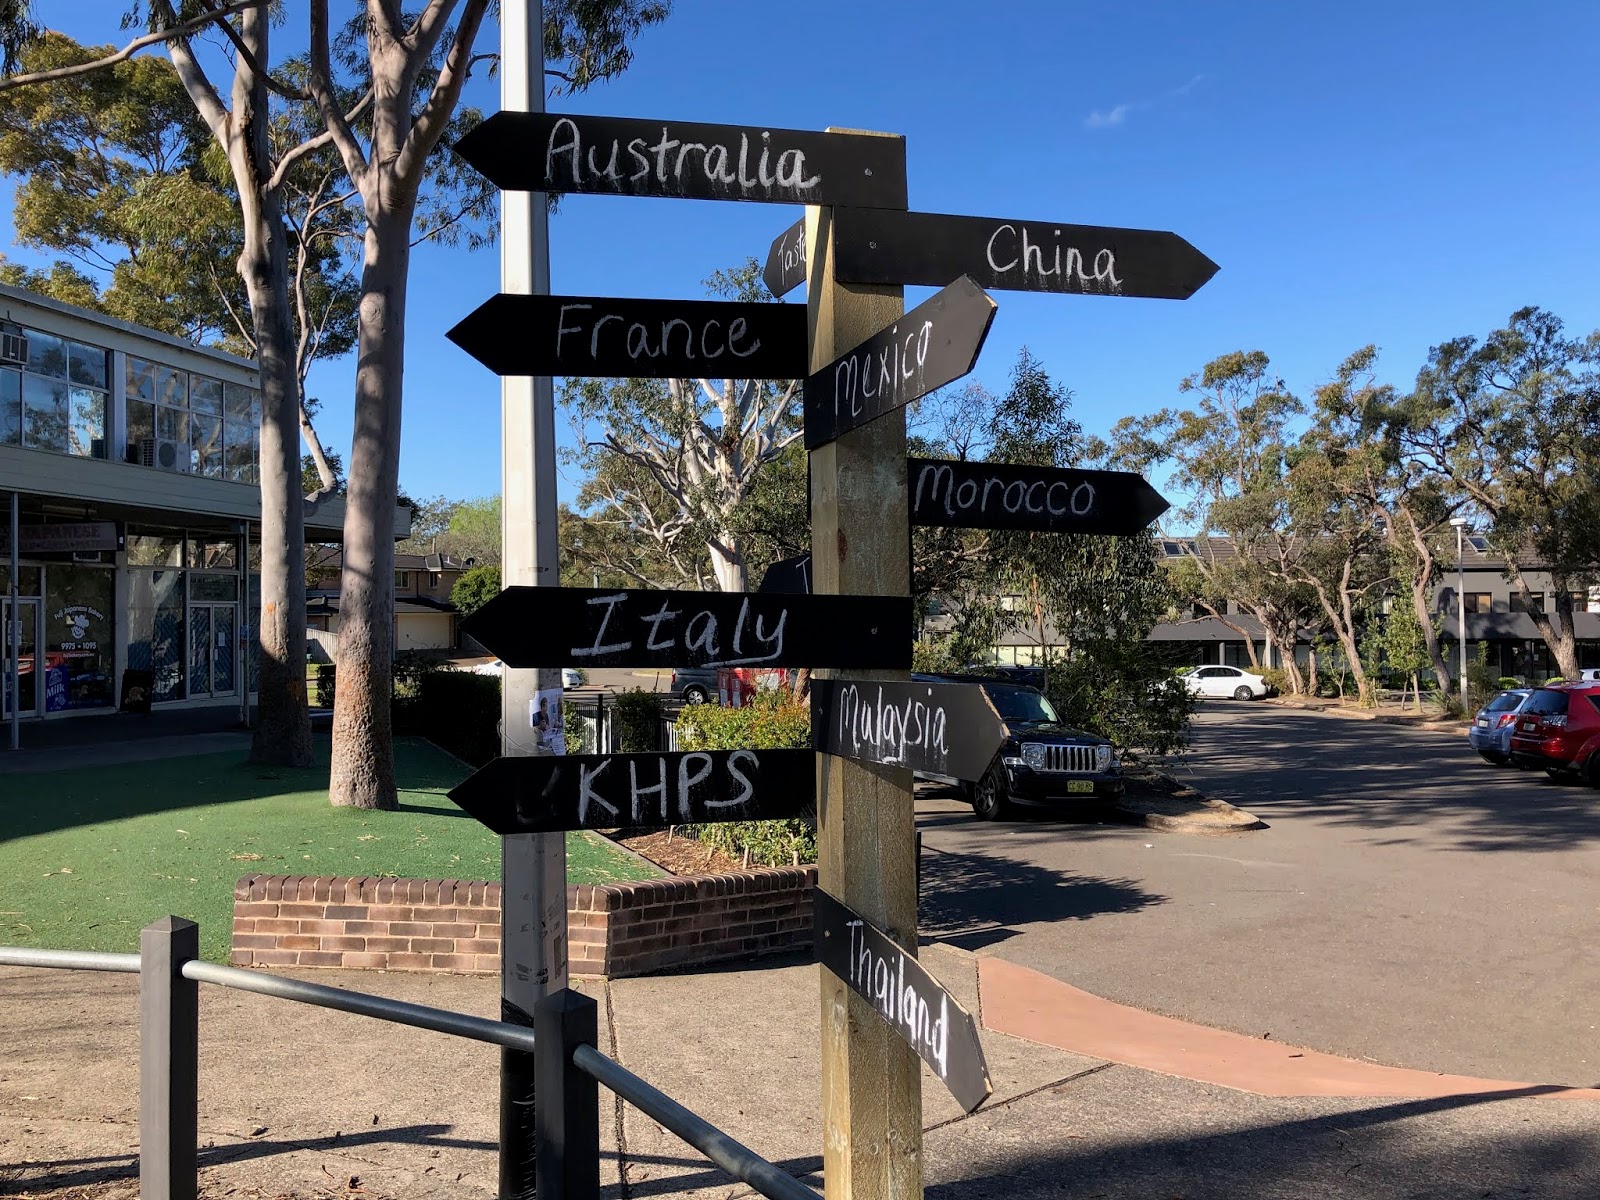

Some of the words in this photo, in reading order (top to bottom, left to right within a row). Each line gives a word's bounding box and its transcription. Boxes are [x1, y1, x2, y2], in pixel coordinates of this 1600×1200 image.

[544, 118, 821, 191] Australia
[986, 224, 1124, 285] China
[556, 303, 761, 359] France
[834, 320, 933, 418] Mexico
[914, 463, 1096, 516] Morocco
[61, 642, 76, 650] 9975
[83, 642, 97, 650] 1095
[571, 592, 788, 668] Italy
[46, 683, 65, 698] Milk
[839, 684, 949, 763] Malaysia
[579, 751, 760, 824] KHPS
[846, 920, 949, 1078] Thailand
